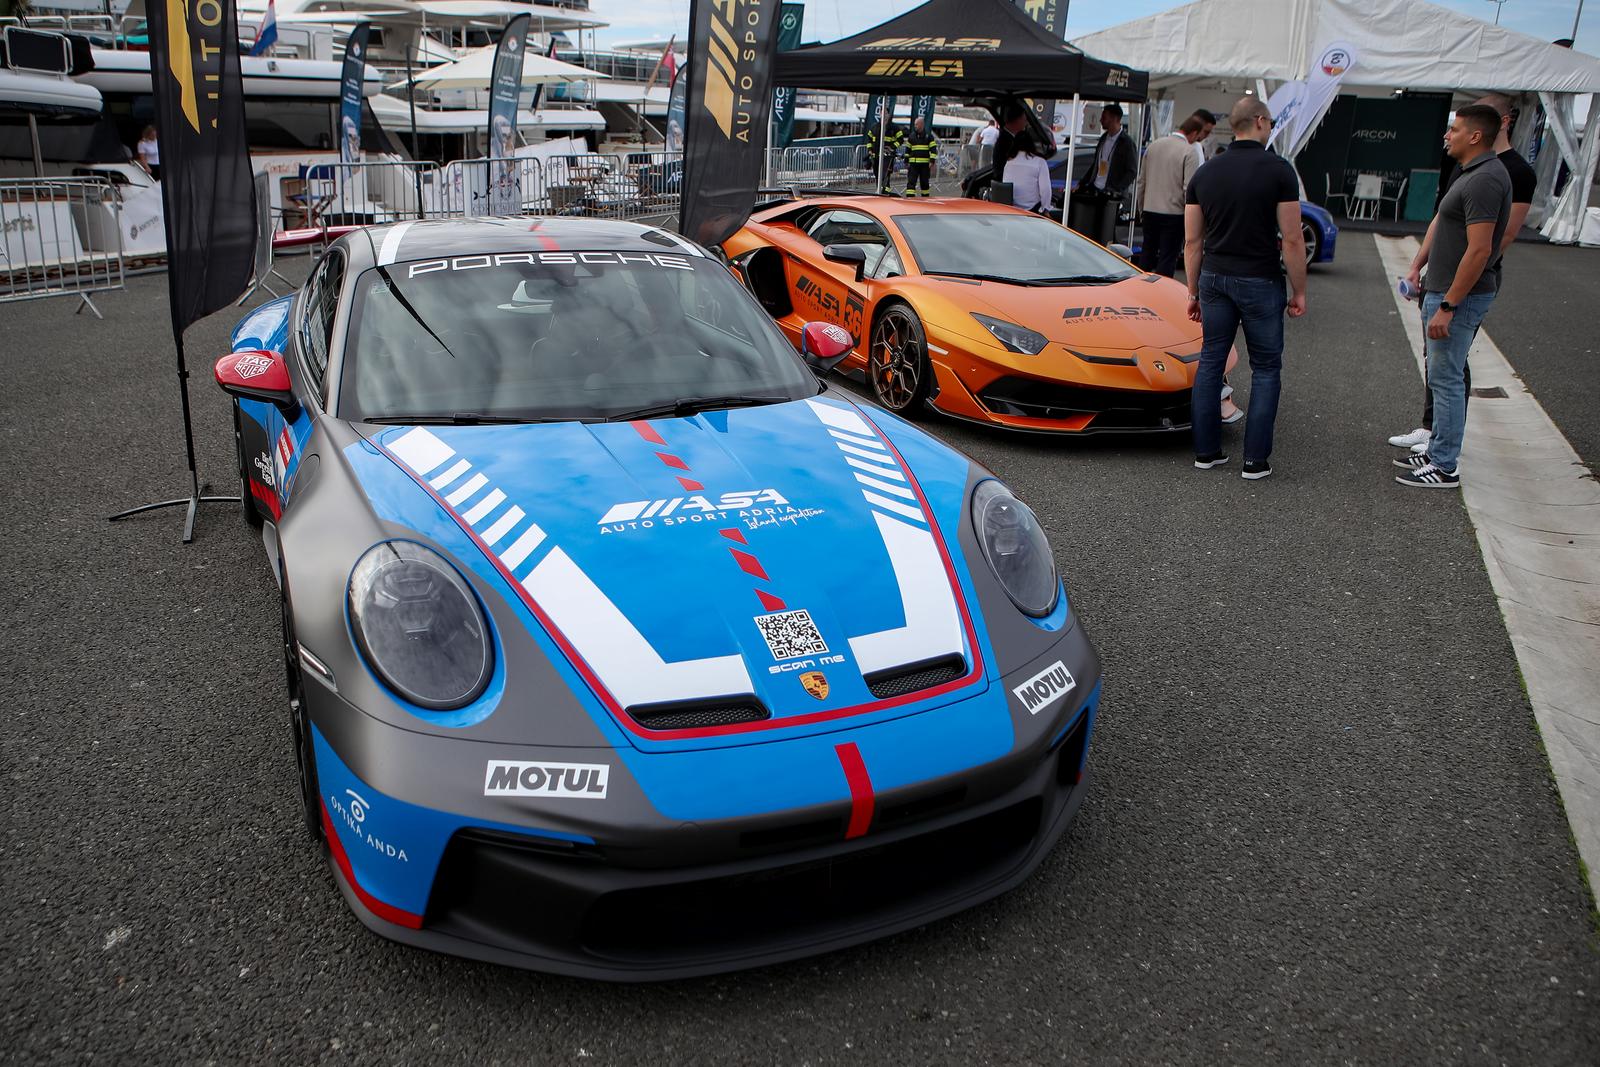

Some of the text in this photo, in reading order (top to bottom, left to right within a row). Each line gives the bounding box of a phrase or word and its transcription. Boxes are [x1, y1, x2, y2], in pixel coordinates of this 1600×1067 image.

[908, 60, 964, 77] ASA
[736, 76, 753, 143] AUTO
[1352, 130, 1396, 139] ARCON
[408, 251, 694, 278] PORSCHE
[844, 304, 862, 339] 36
[1103, 306, 1158, 316] ASA
[236, 363, 266, 377] HEUER
[243, 355, 271, 366] TAG
[679, 488, 790, 512] ASA
[600, 504, 797, 535] AUTO SPORT ADRIA
[1019, 666, 1073, 710] MOTUL
[487, 765, 605, 793] MOTUL
[331, 795, 409, 863] OPTIKA ANDA
